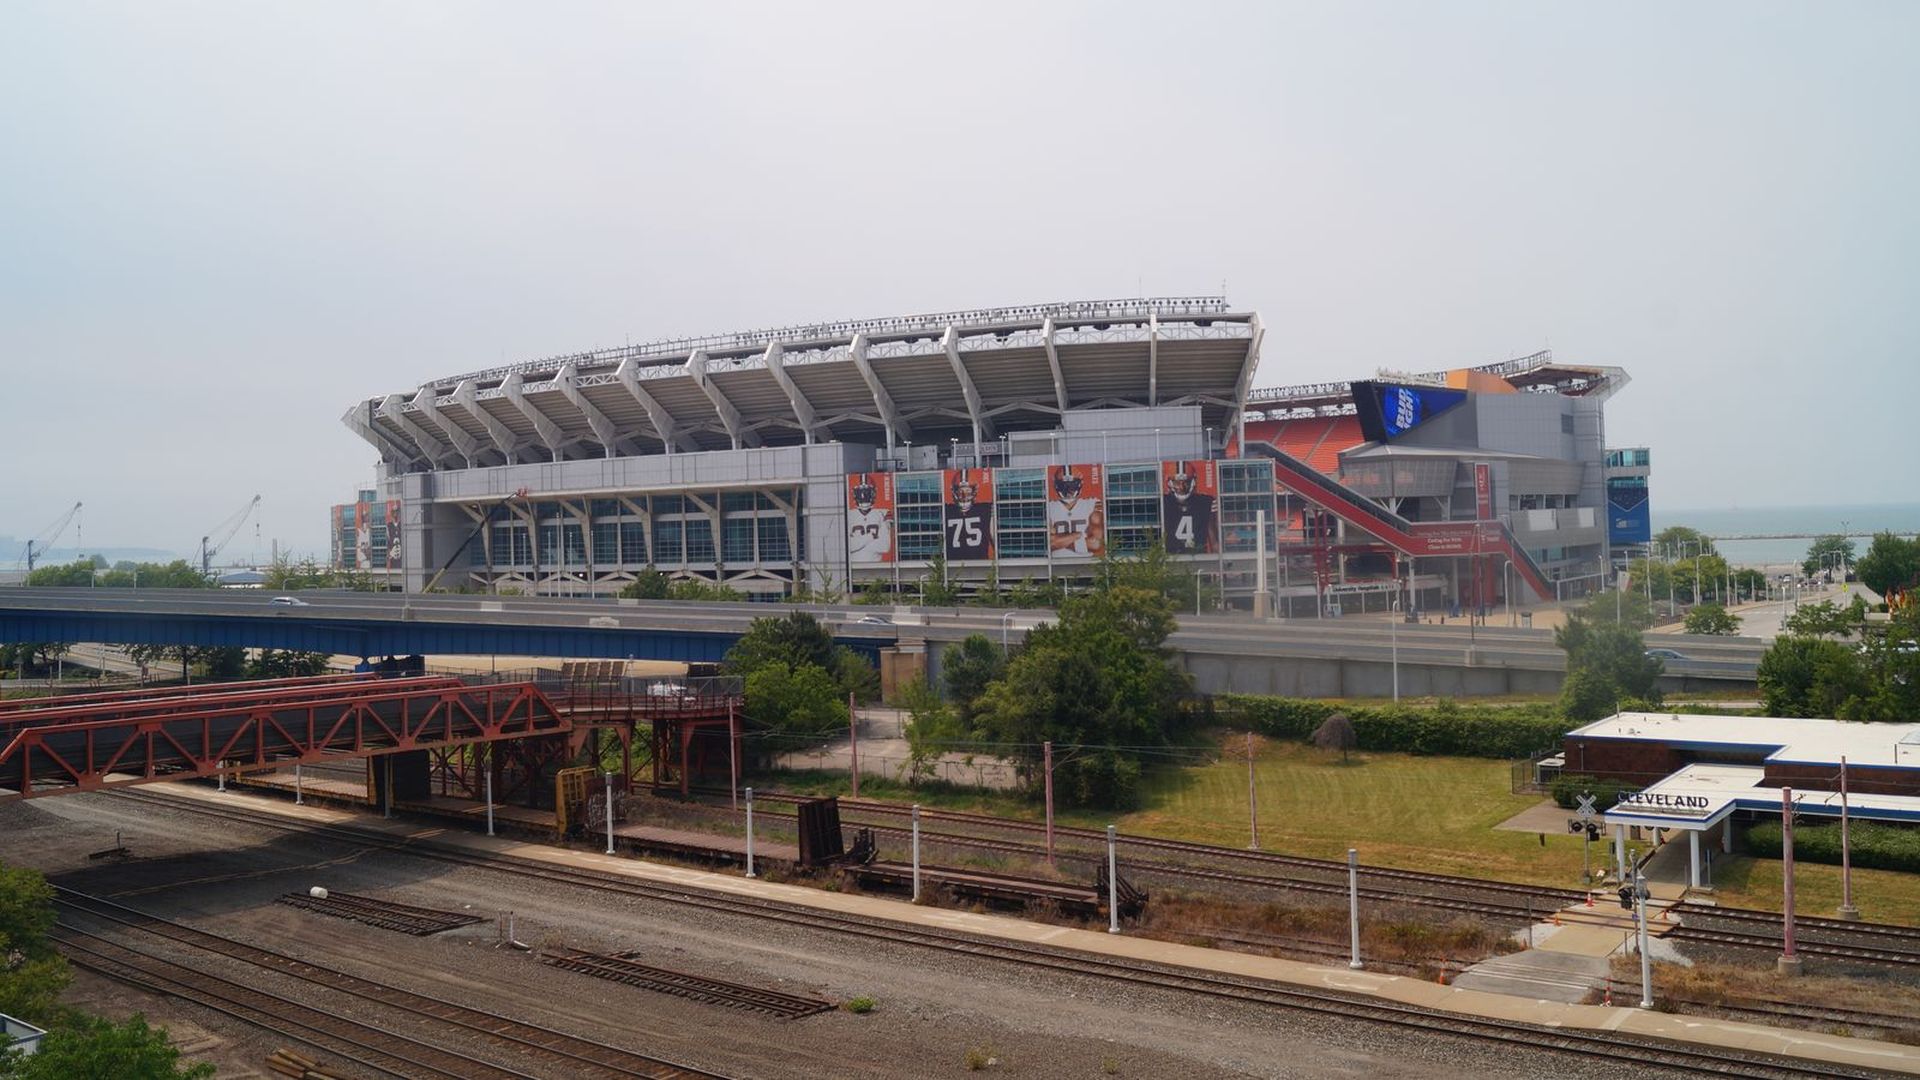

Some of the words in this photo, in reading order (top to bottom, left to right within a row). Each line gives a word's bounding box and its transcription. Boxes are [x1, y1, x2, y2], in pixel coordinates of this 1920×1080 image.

[1395, 388, 1406, 429] BUD
[947, 516, 983, 548] 75
[1175, 515, 1194, 548] 4
[1617, 790, 1709, 808] CLEVELAND
